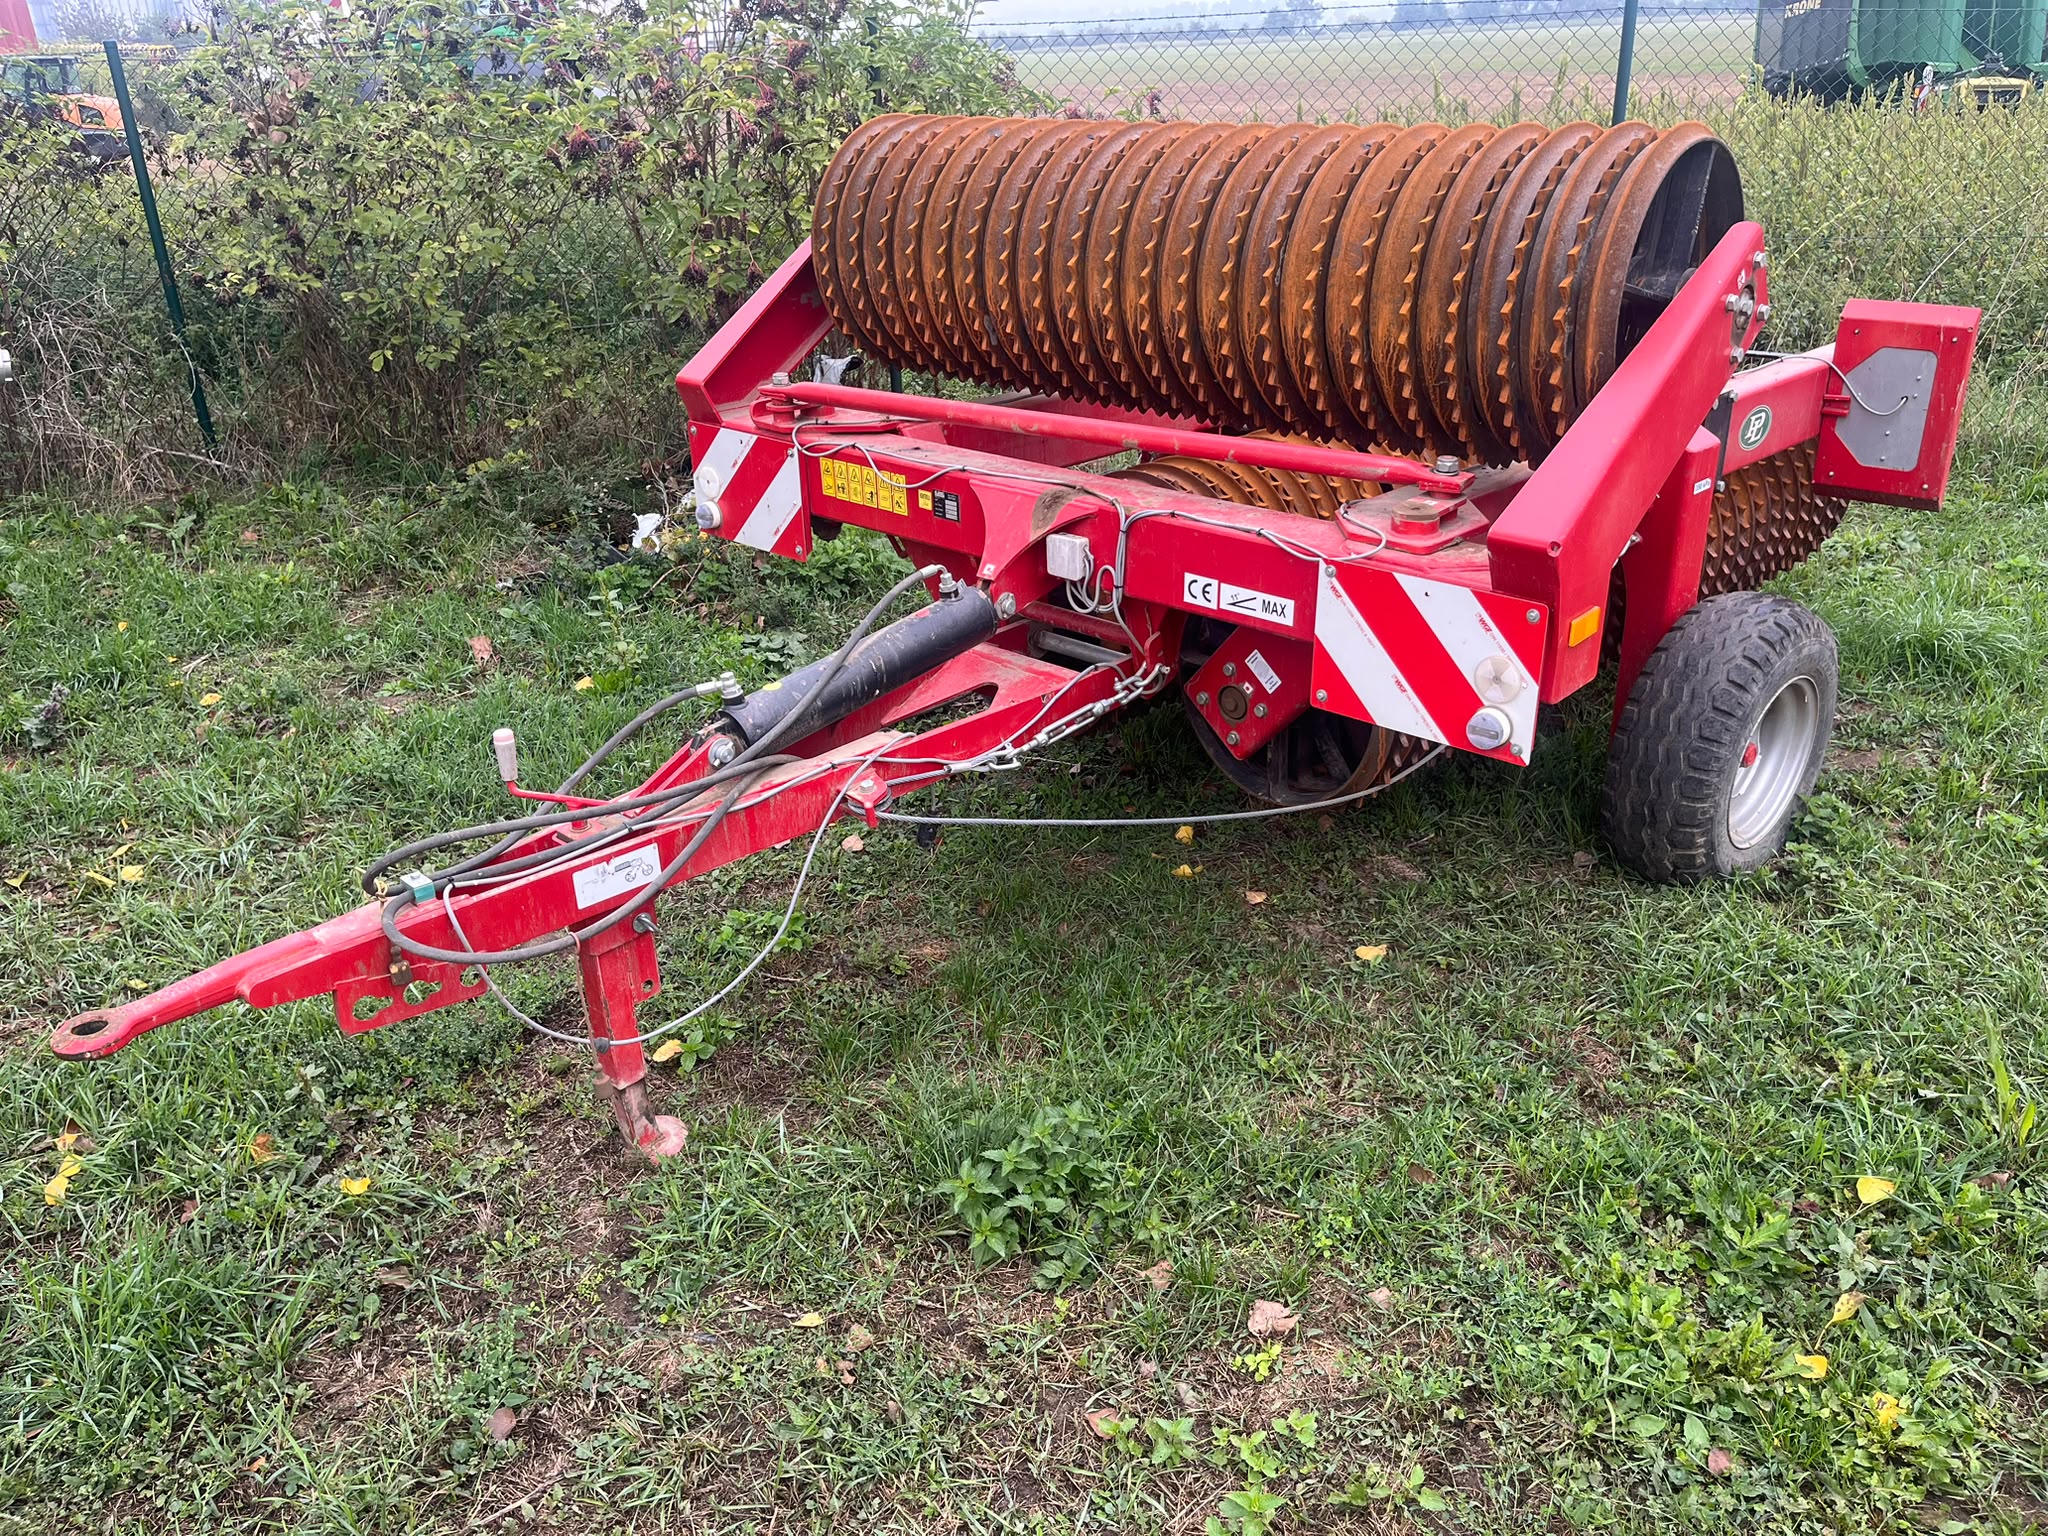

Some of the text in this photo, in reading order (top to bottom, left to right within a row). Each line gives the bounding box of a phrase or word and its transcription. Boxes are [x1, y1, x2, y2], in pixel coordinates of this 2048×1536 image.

[1784, 0, 1822, 19] KRONE
[1188, 579, 1213, 603] CE
[1261, 599, 1287, 618] MAX
[1478, 617, 1492, 633] WGF
